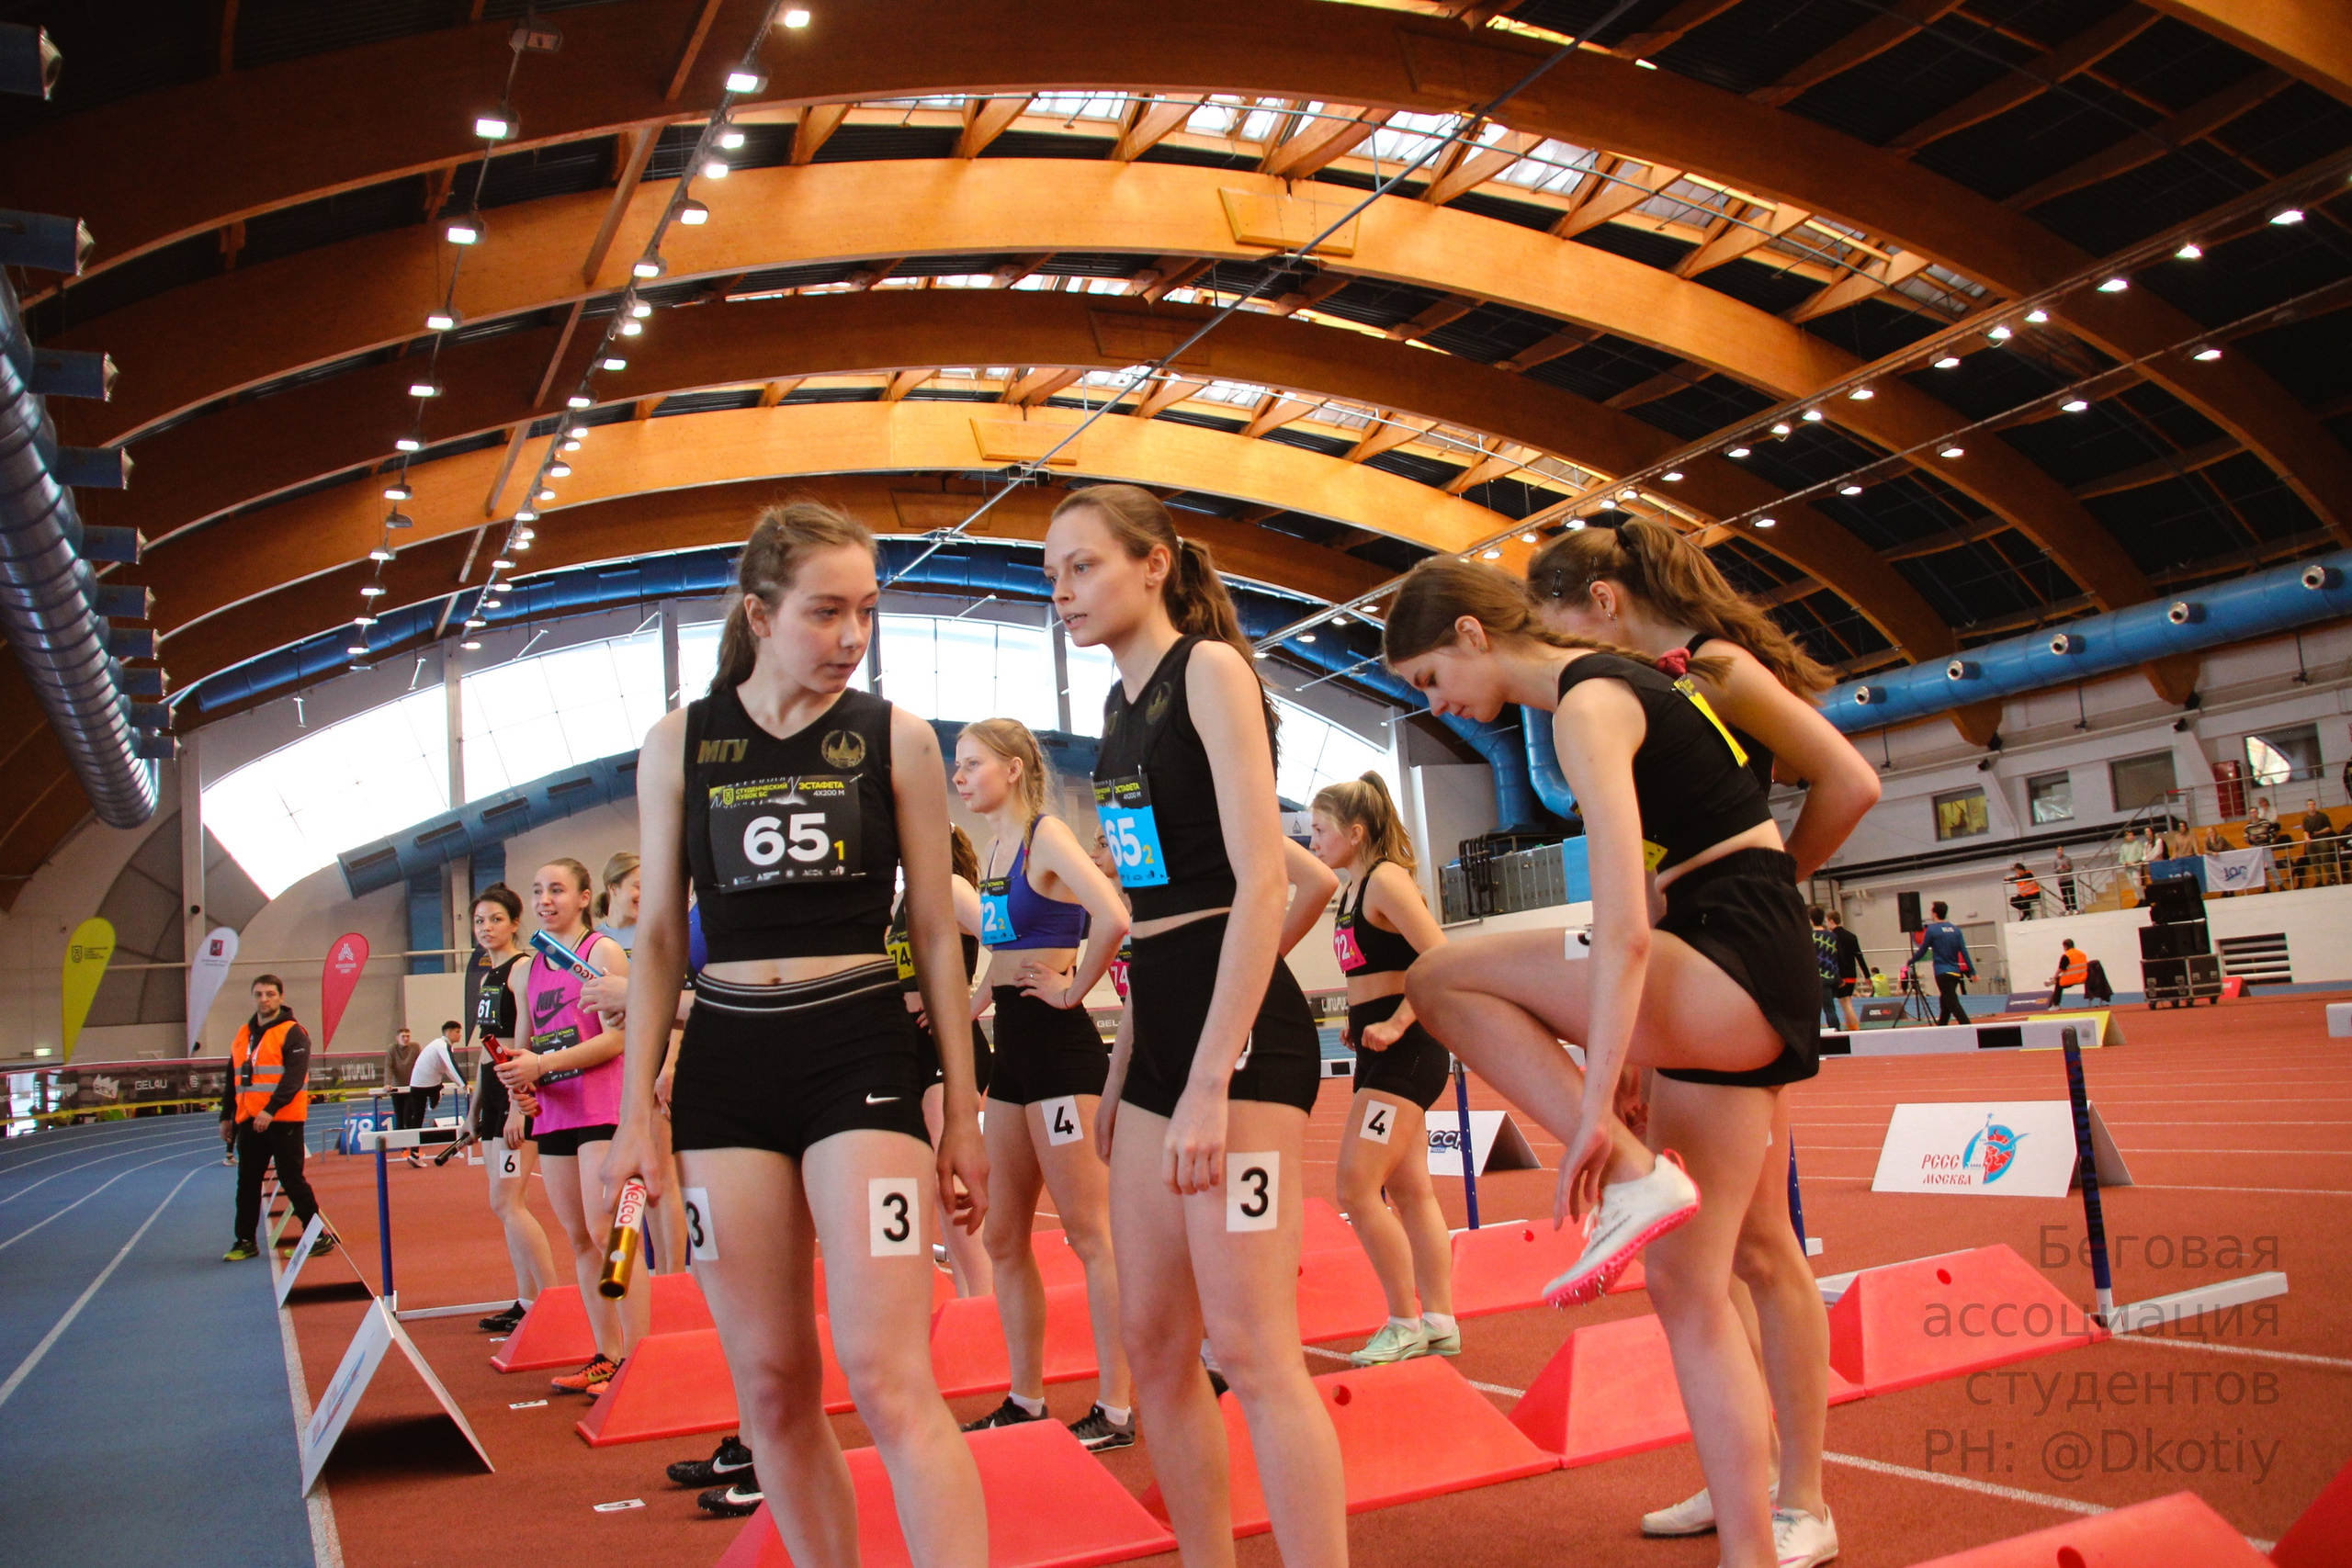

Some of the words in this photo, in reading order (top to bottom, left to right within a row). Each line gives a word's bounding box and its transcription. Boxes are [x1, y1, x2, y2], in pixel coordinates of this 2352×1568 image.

[696, 739, 749, 763] МГУ
[735, 783, 787, 795] СТУДЕНЧЕСКИЙ
[798, 782, 844, 790] ЭСТАФЕТА
[736, 793, 758, 801] КУБОК
[743, 812, 830, 866] 65
[833, 840, 844, 861] 1
[1105, 817, 1142, 868] 65
[1142, 844, 1155, 864] 2
[998, 918, 1006, 930] 2
[890, 946, 911, 966] 74
[478, 998, 492, 1018] 61
[537, 987, 566, 1012] NIKE
[1096, 1019, 1121, 1028] GEL
[95, 1084, 115, 1098] REX
[135, 1078, 167, 1091] GEL4U
[1054, 1106, 1074, 1135] 4
[1368, 1110, 1386, 1135] 4
[503, 1155, 516, 1173] 6
[1921, 1154, 1961, 1170] РССС
[1922, 1174, 1972, 1185] МОСКВА
[618, 1179, 648, 1224] Nelco
[1240, 1167, 1269, 1217] 3
[685, 1201, 705, 1247] 3
[883, 1192, 910, 1242] 3
